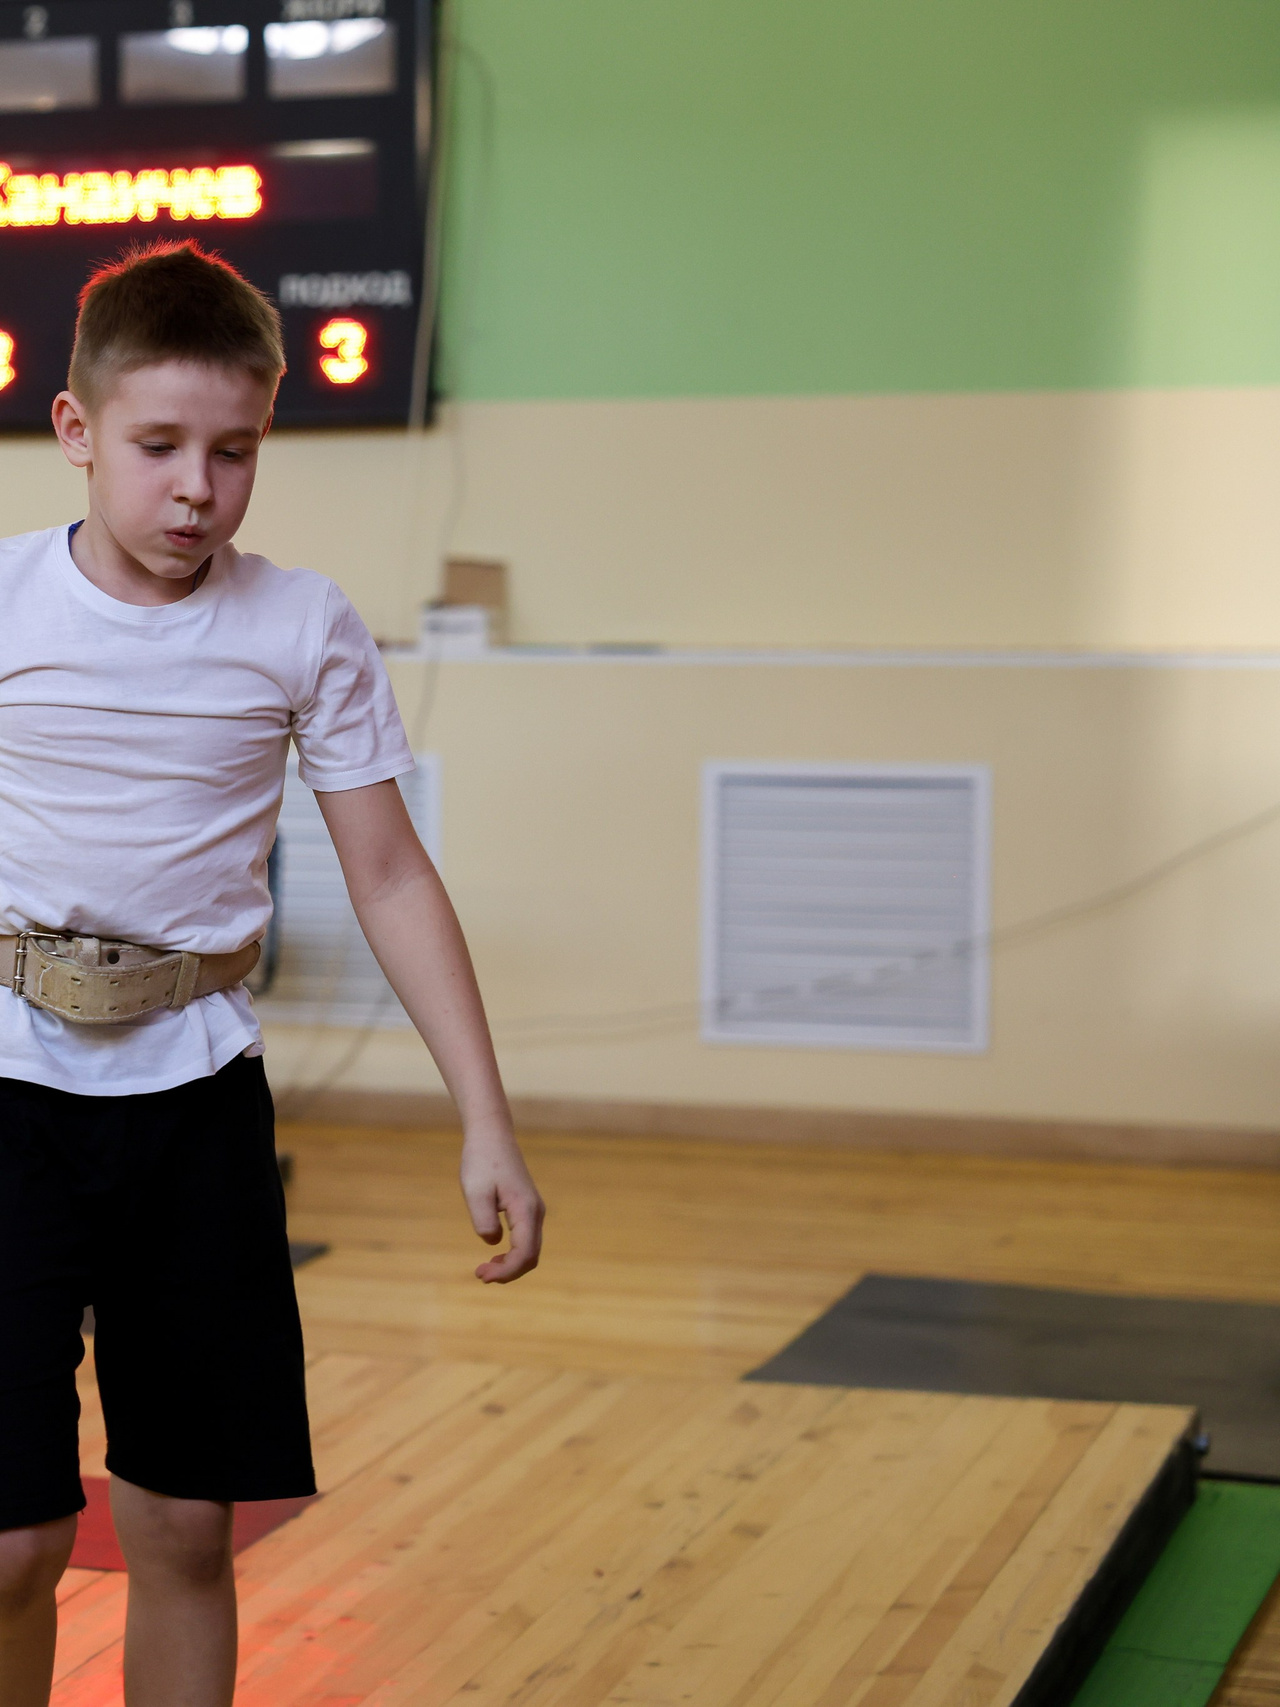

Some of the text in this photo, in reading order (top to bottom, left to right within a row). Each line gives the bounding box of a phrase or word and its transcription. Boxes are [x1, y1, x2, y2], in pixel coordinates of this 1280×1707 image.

[24, 6, 47, 38] 2
[279, 272, 412, 308] ПОДХОД
[320, 318, 368, 383] 3
